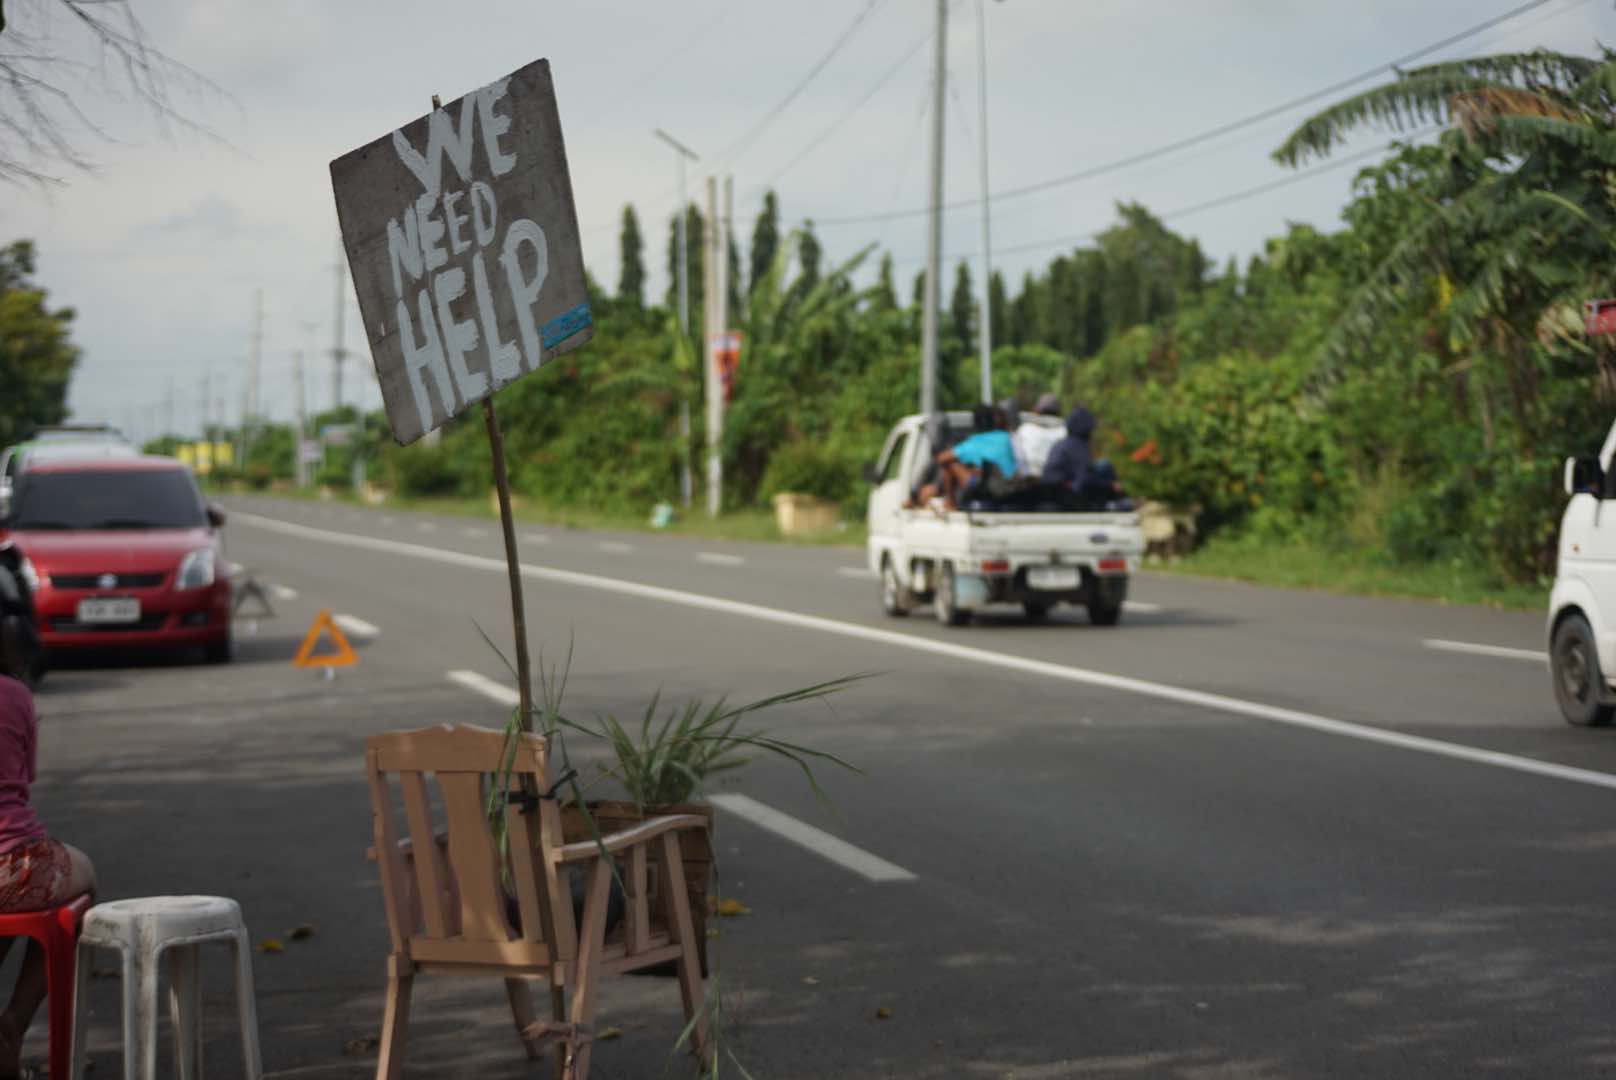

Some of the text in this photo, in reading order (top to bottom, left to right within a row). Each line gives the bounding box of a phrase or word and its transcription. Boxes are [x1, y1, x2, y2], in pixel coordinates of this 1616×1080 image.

[393, 77, 518, 192] WE
[387, 181, 498, 297] NEED
[397, 219, 548, 433] HELP
